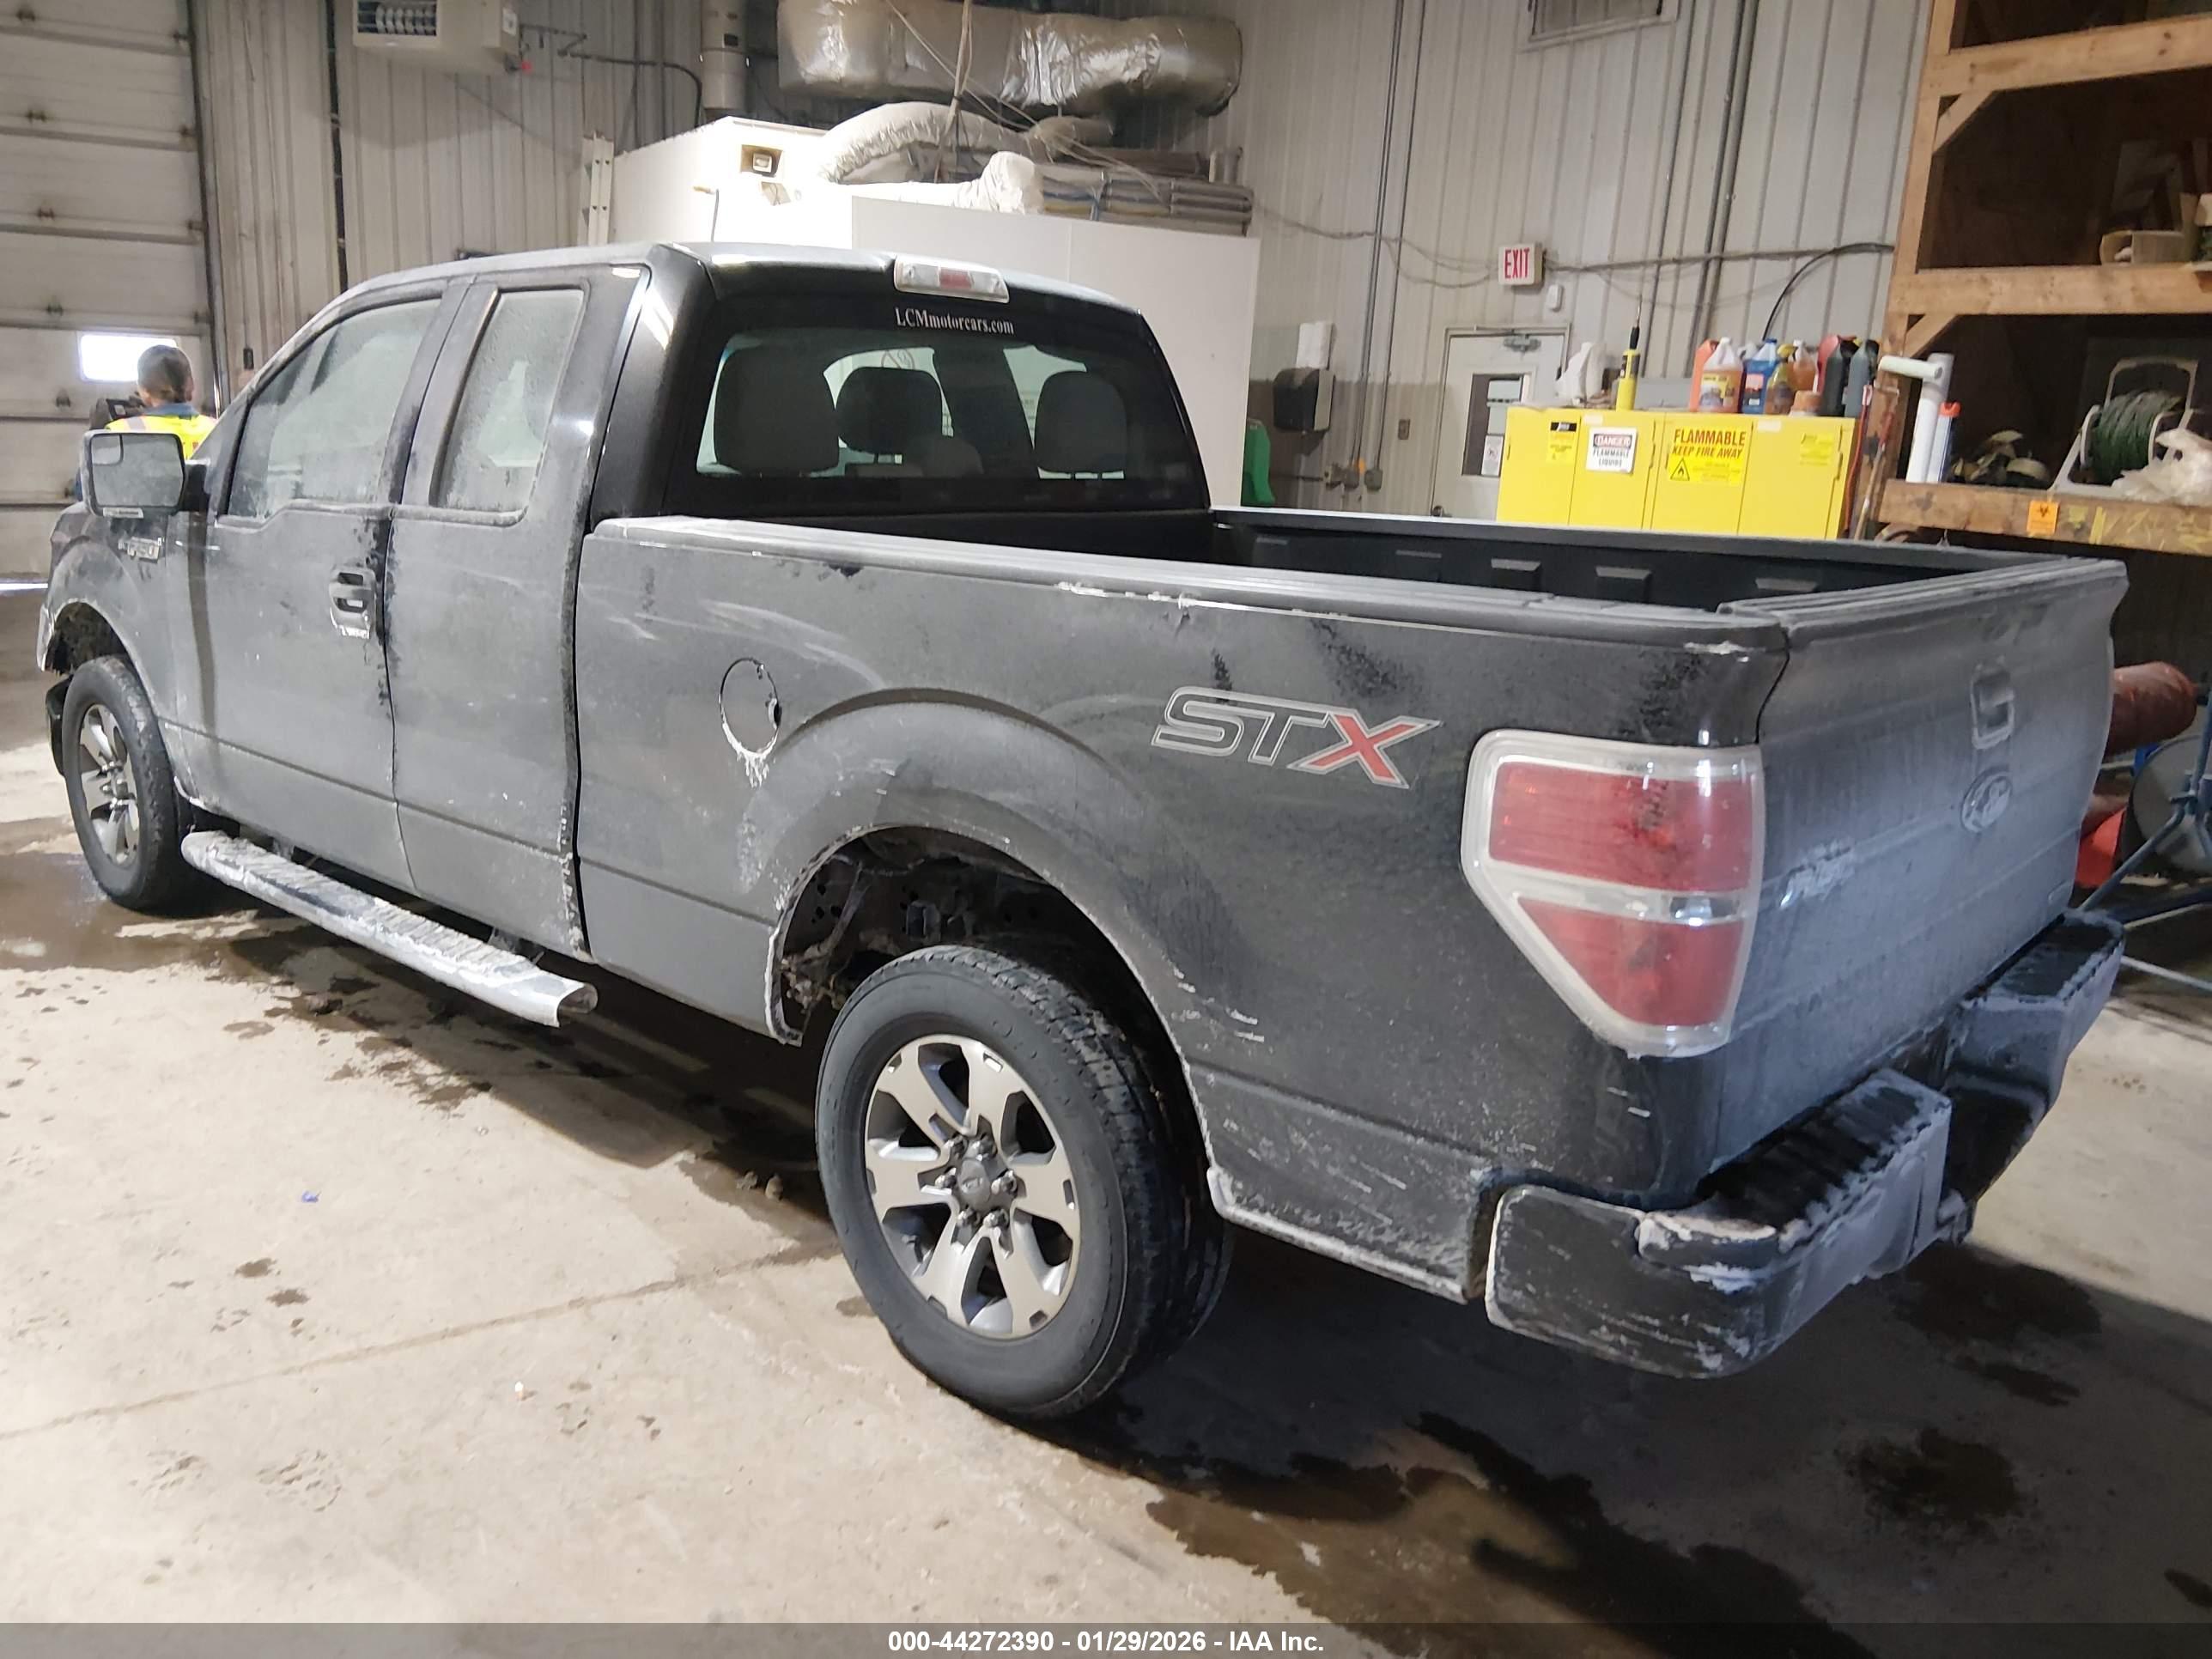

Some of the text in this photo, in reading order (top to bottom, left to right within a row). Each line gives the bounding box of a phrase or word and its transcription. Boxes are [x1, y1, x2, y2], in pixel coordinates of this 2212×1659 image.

[1504, 248, 1529, 279] EXIT
[895, 307, 1015, 335] LCMmotorcars.com
[1596, 434, 1631, 447] DANGER
[1674, 428, 1747, 446] FLAMMABLE
[1673, 446, 1742, 459] KEEP FIRE AWAY
[1152, 686, 1446, 789] STX
